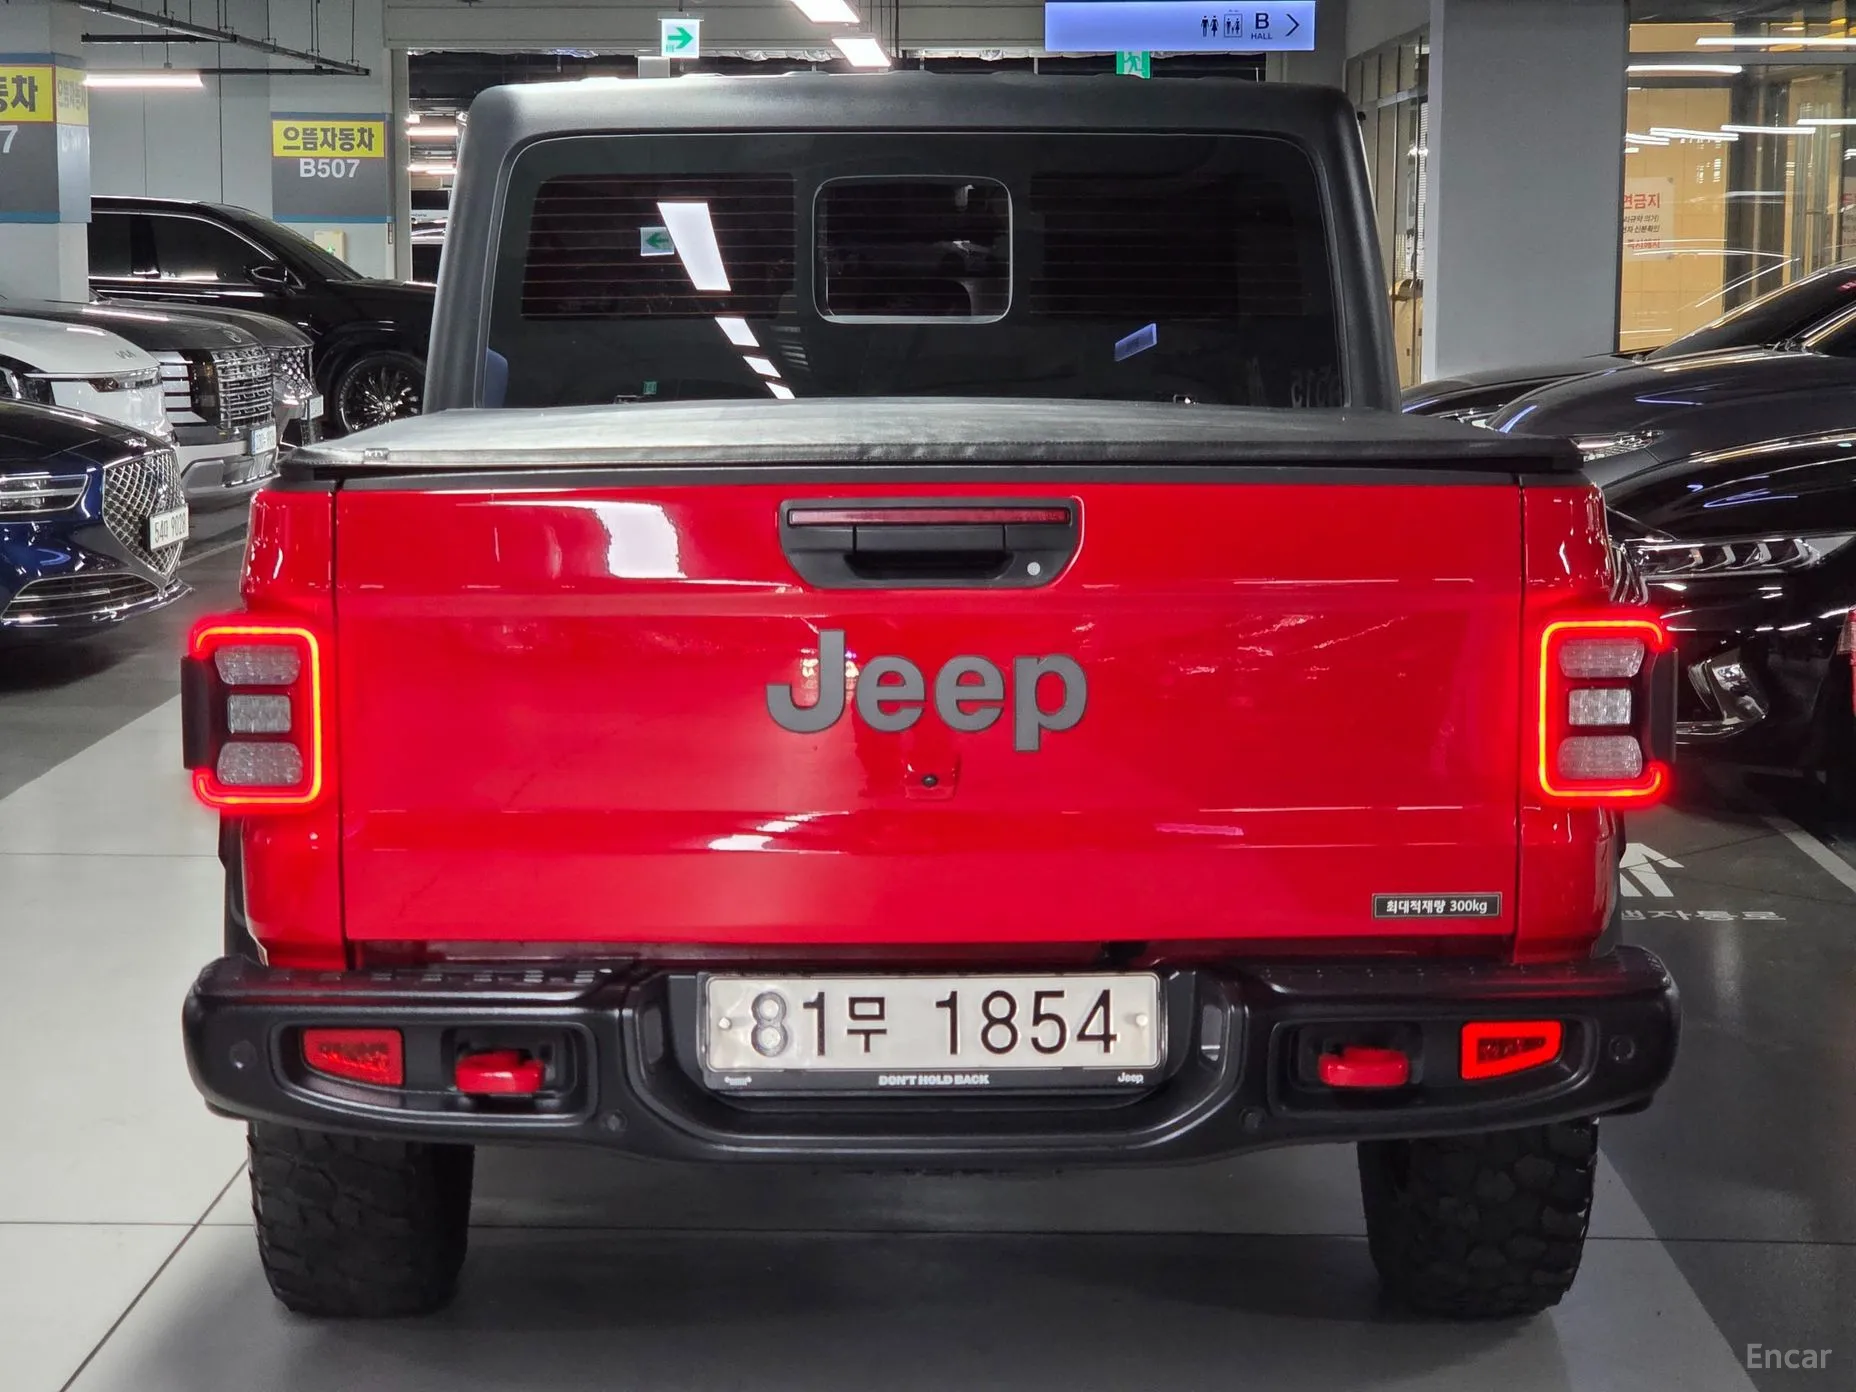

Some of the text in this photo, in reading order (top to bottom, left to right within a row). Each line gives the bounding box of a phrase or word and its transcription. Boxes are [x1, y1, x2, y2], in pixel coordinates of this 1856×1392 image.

[1255, 13, 1270, 29] B
[283, 126, 374, 151] 으뜸자동차
[300, 158, 360, 178] B507
[765, 628, 1088, 752] Jeep
[1386, 899, 1488, 914] 최대적재량 300kg
[750, 988, 1119, 1058] 81무 1854
[878, 1072, 1144, 1086] DON'T HOLD BACK Jeep
